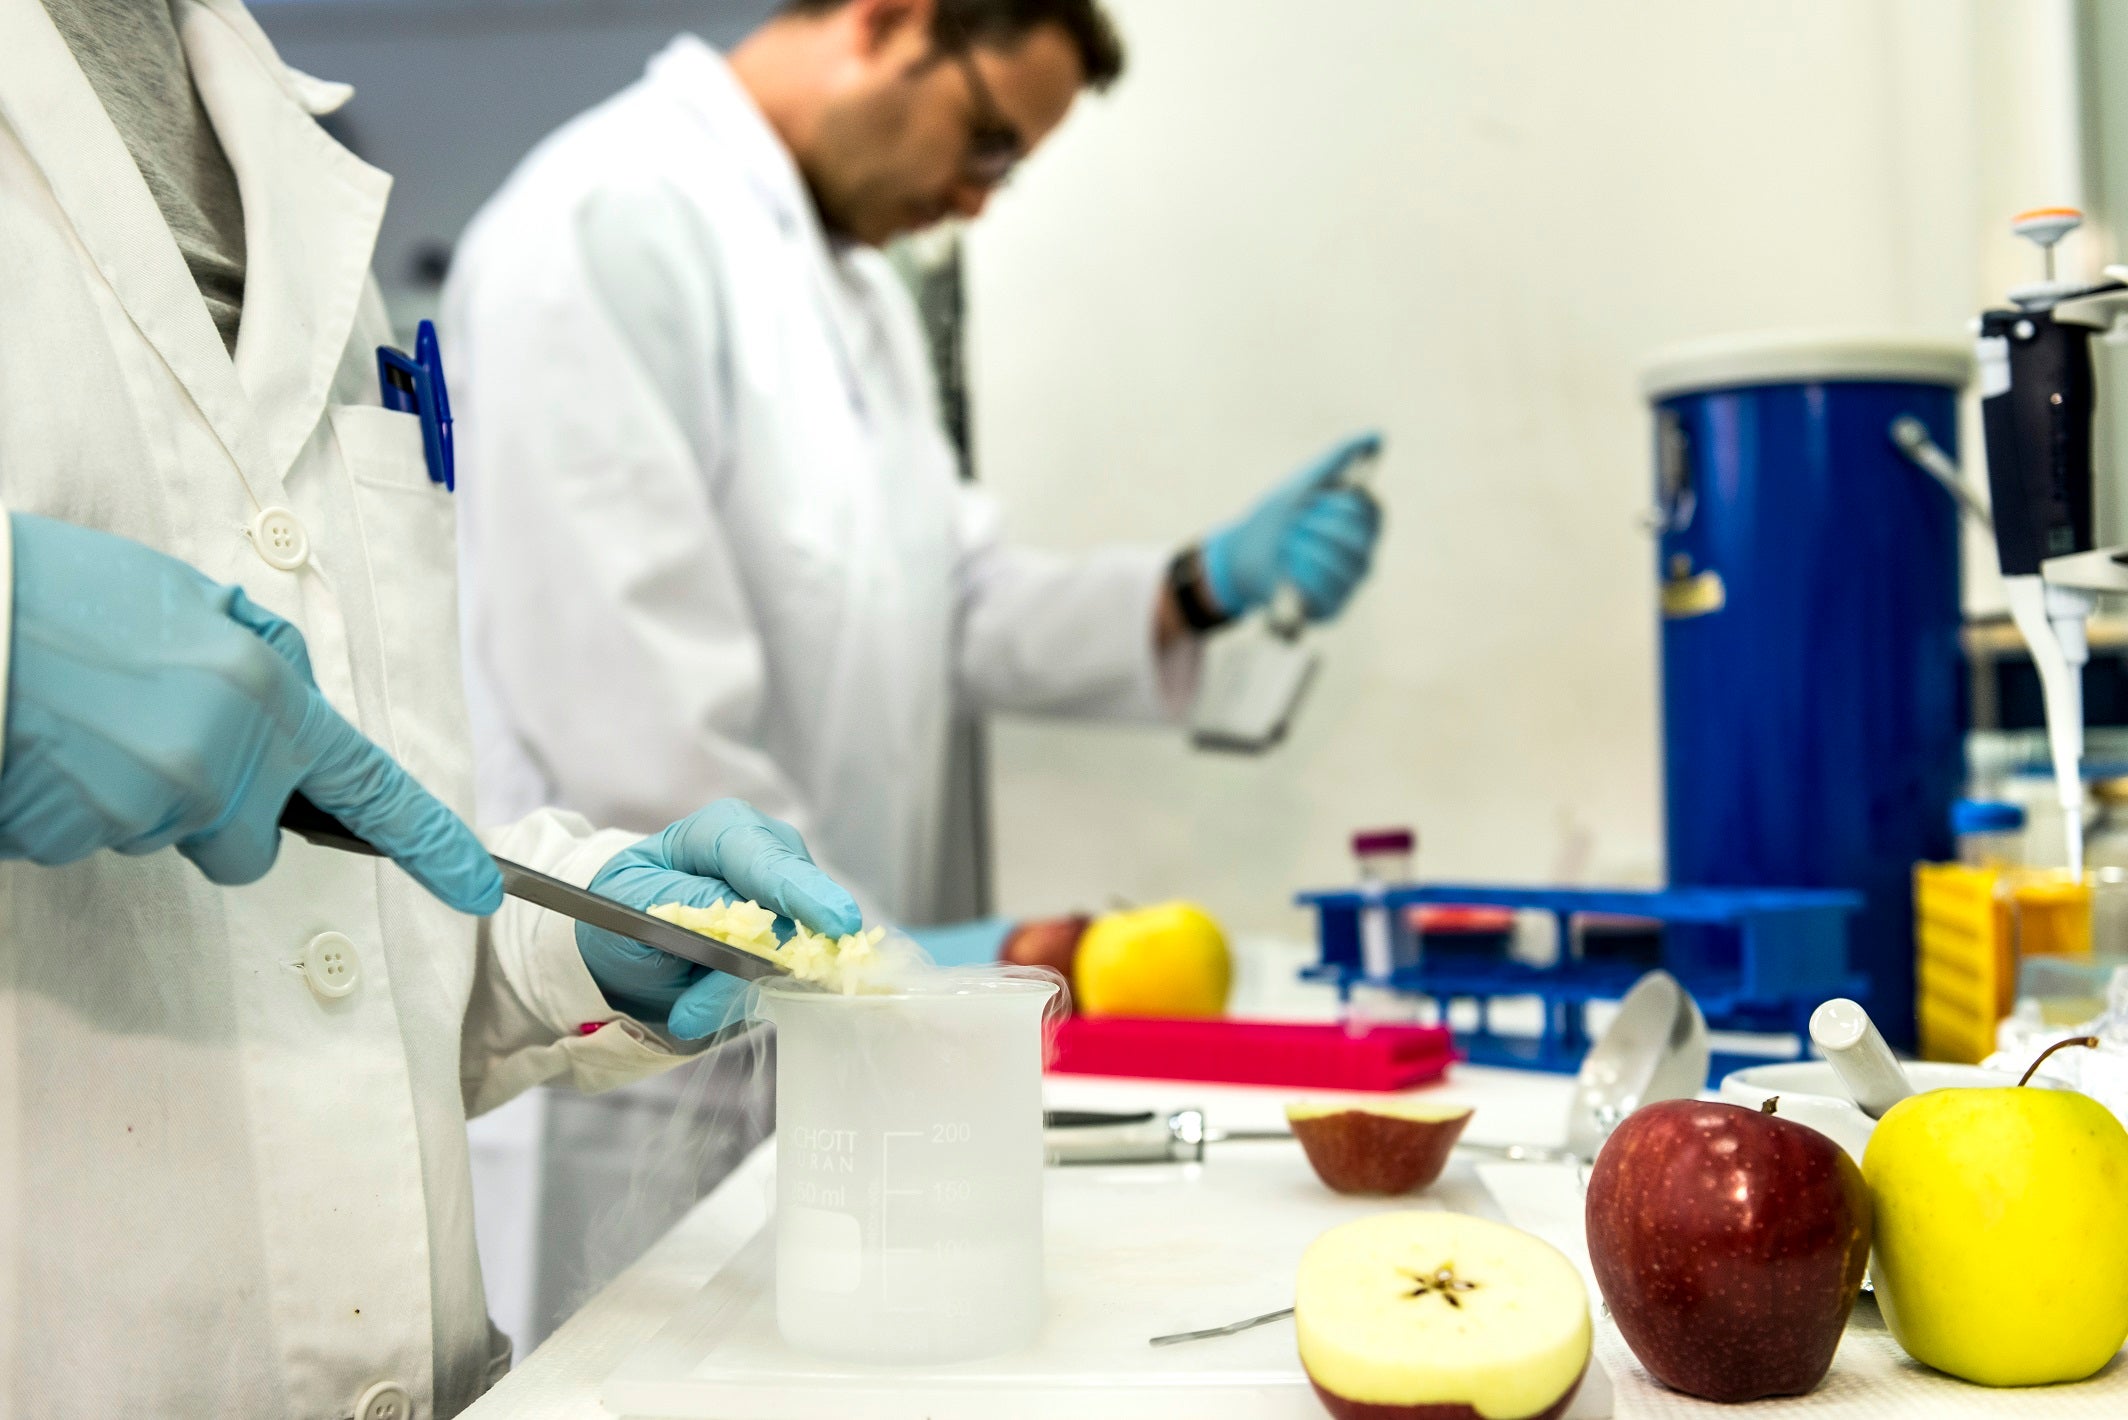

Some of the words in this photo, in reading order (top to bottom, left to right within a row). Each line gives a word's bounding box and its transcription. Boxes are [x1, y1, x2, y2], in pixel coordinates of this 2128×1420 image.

[931, 1122, 971, 1144] 200
[788, 1152, 854, 1174] URAN
[822, 1185, 845, 1208] ml
[934, 1179, 971, 1203] 150
